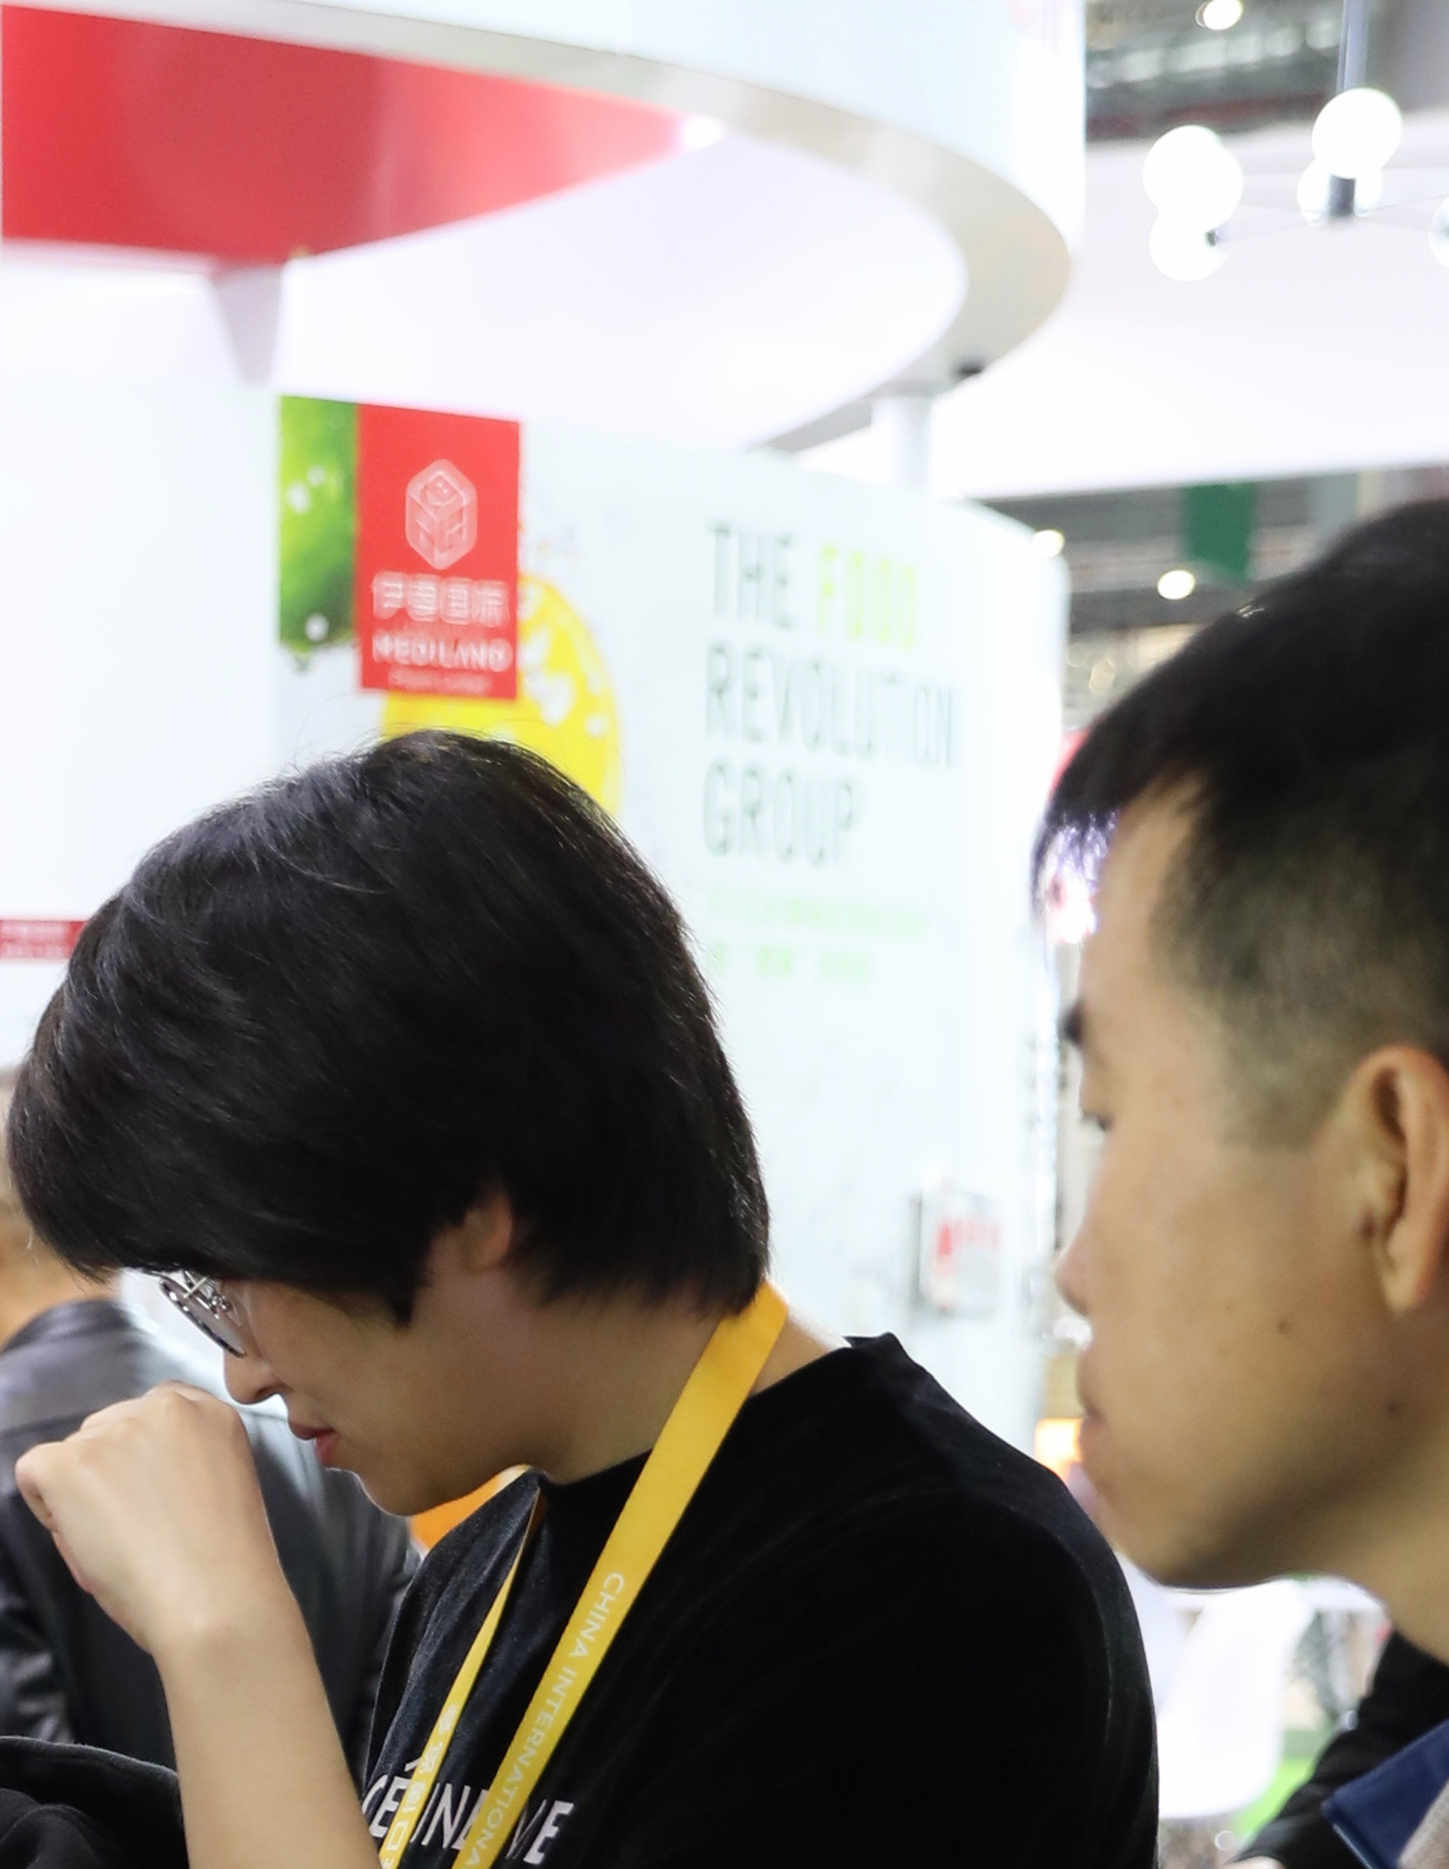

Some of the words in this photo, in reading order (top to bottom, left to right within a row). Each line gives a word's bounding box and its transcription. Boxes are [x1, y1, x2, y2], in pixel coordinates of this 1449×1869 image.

[709, 521, 795, 631] THE
[816, 543, 921, 653] FOOD
[372, 628, 513, 674] MEDILAND
[706, 645, 961, 774] REVOLUTION
[704, 761, 863, 869] GROUP
[569, 1571, 625, 1658] CHINA
